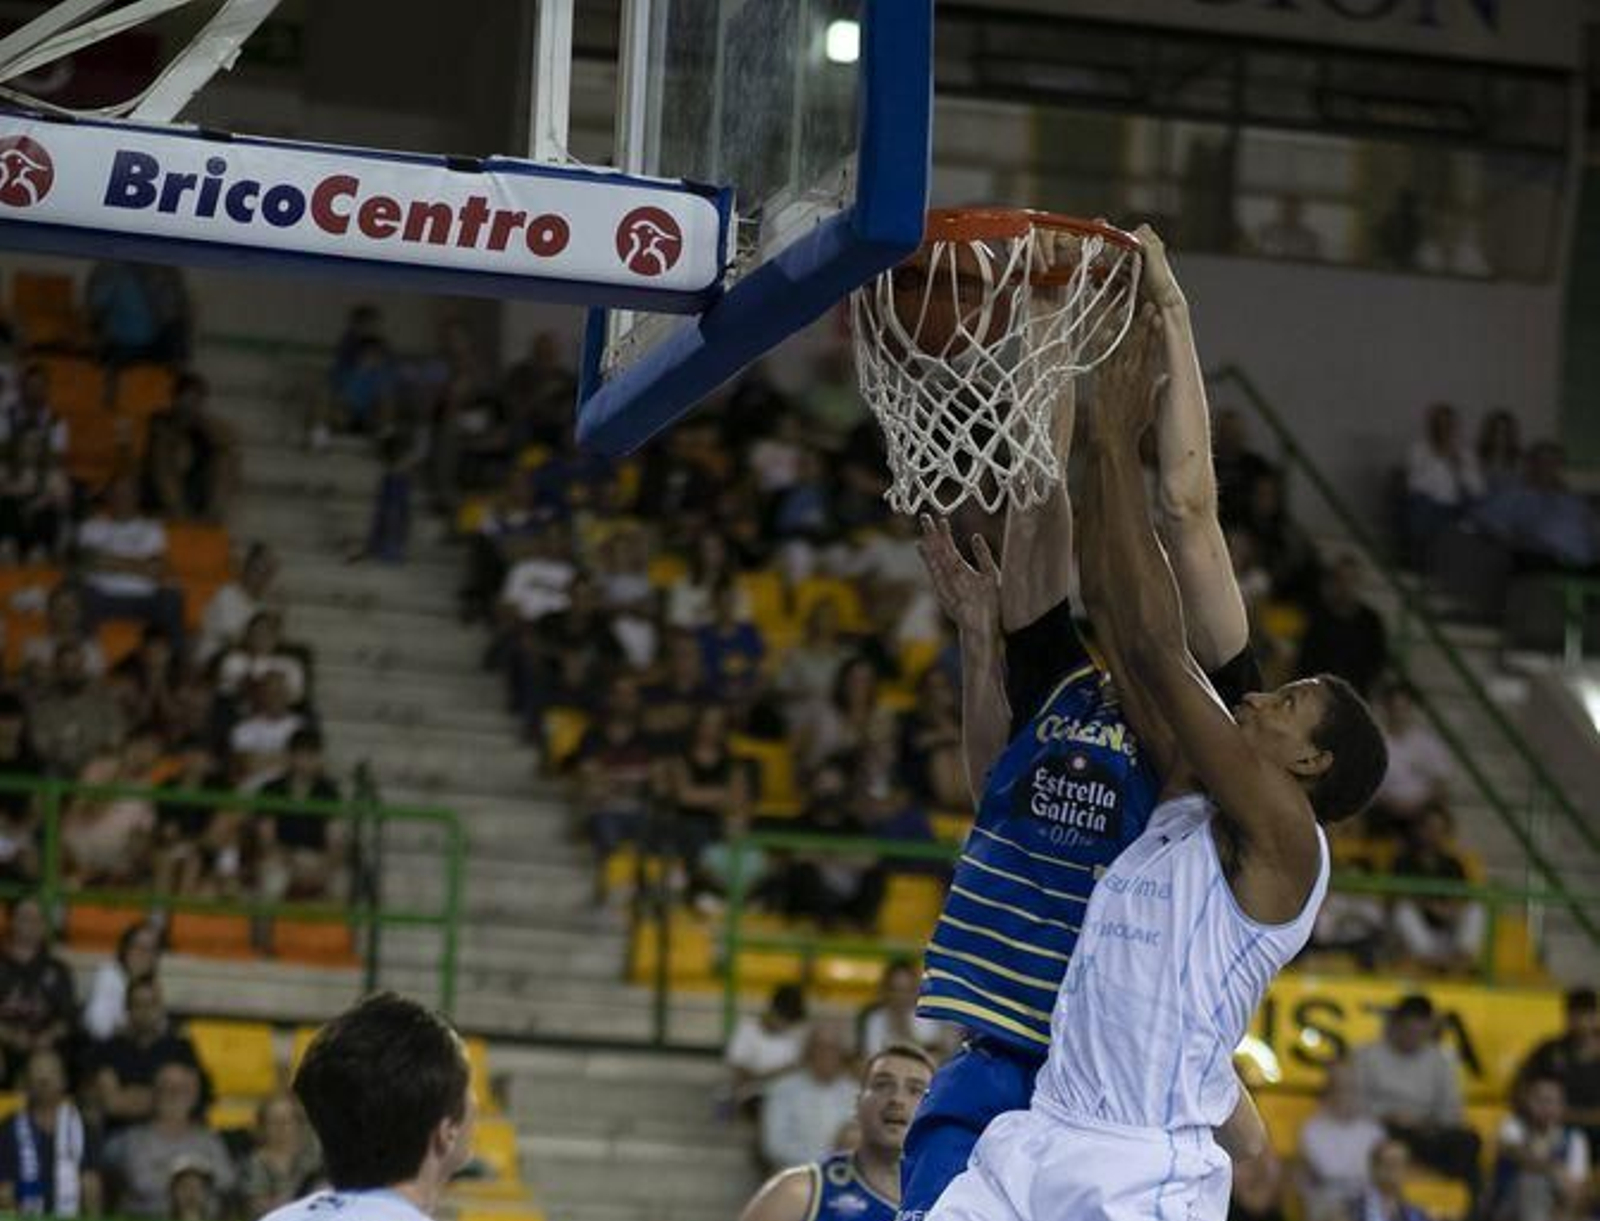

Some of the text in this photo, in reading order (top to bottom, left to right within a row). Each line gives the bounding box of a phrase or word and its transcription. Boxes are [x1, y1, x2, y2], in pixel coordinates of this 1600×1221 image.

[103, 149, 571, 258] BricoCentro
[1031, 766, 1118, 809] Estrella
[1030, 792, 1107, 833] Galicia
